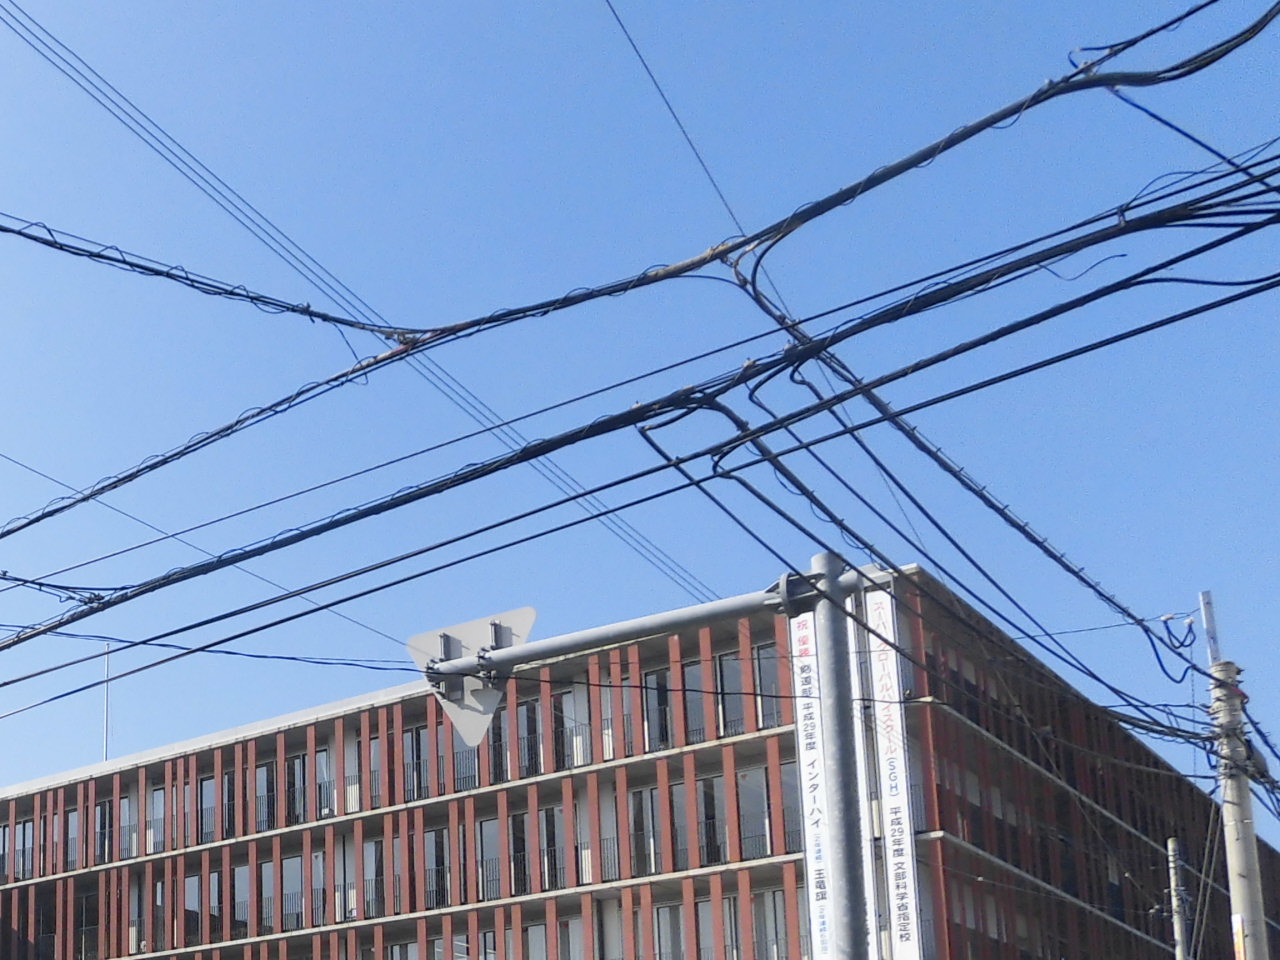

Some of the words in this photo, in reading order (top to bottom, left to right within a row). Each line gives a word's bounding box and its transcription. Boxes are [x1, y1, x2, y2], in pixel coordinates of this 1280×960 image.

[802, 702, 817, 751] 平成29年度
[806, 759, 823, 829] インターハイ
[889, 806, 904, 857] 平成29年度
[893, 861, 911, 942] 文部科学省指定校
